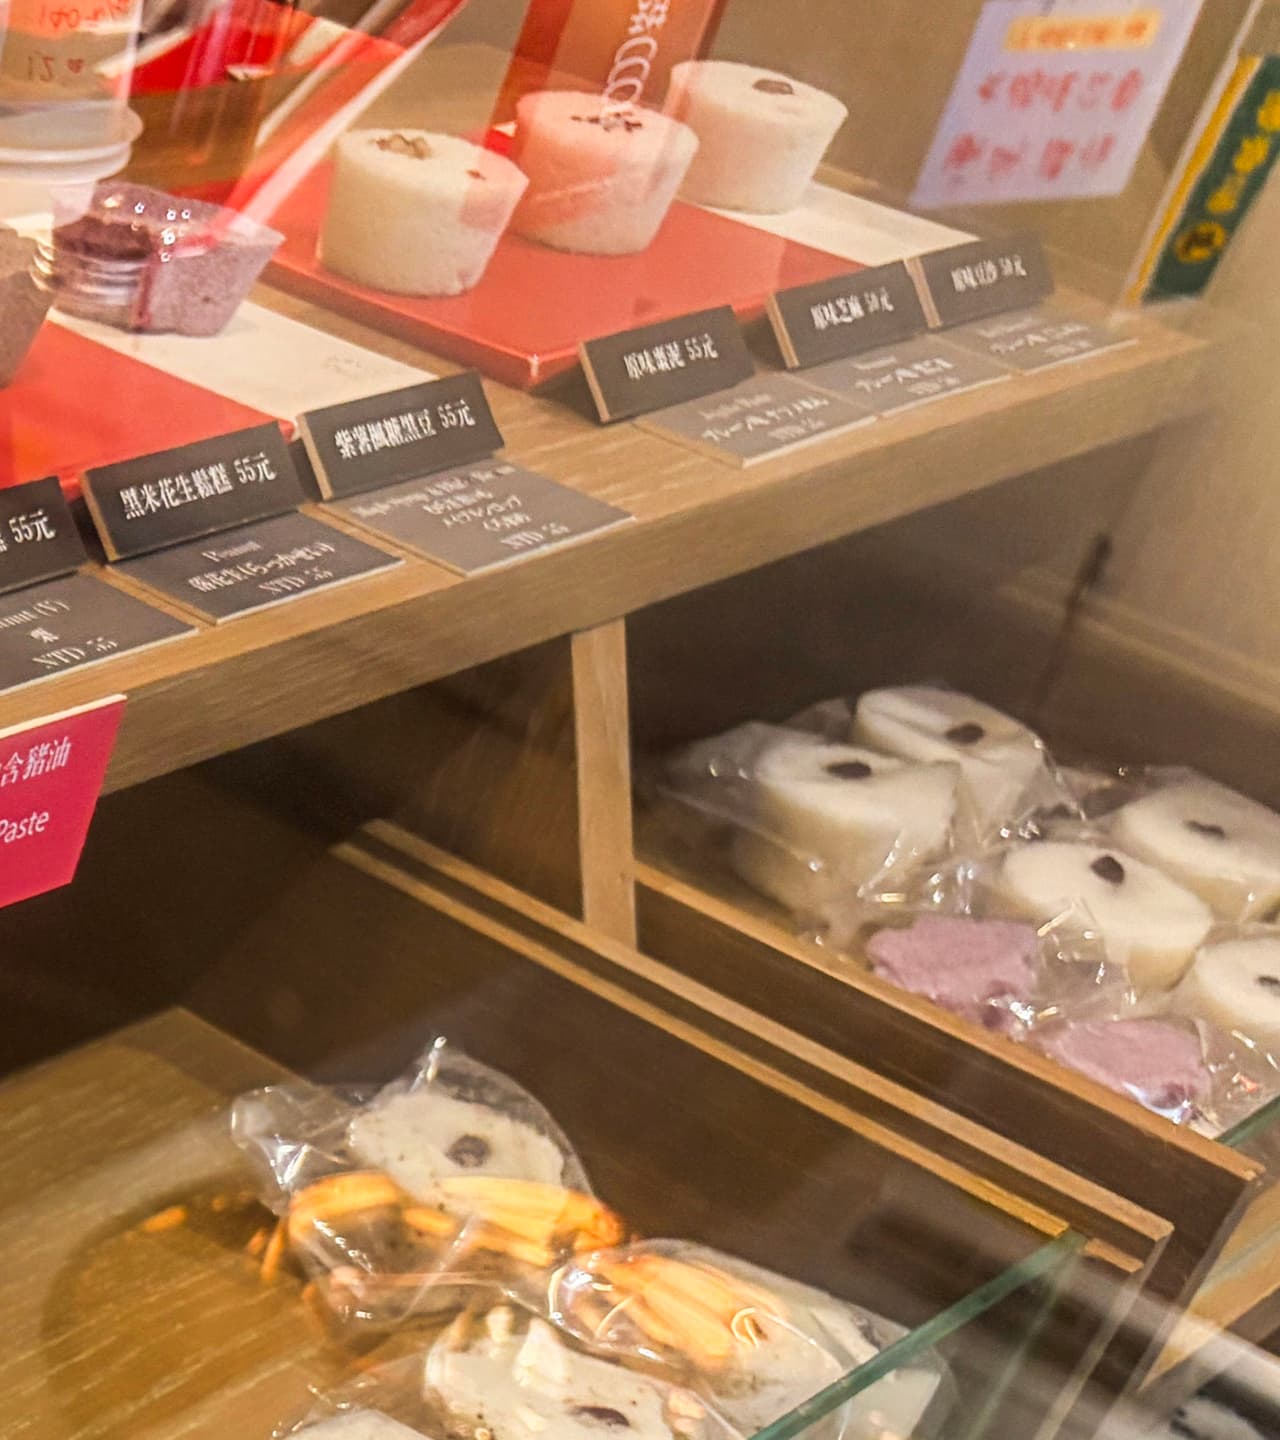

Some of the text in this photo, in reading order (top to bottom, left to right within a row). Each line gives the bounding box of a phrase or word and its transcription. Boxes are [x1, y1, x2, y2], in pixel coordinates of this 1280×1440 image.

[684, 332, 719, 360] 55元
[437, 398, 477, 430] 55元
[119, 451, 277, 520] 黑米花生鬆糕 55元
[8, 509, 57, 546] 55元
[32, 646, 86, 670] NTD
